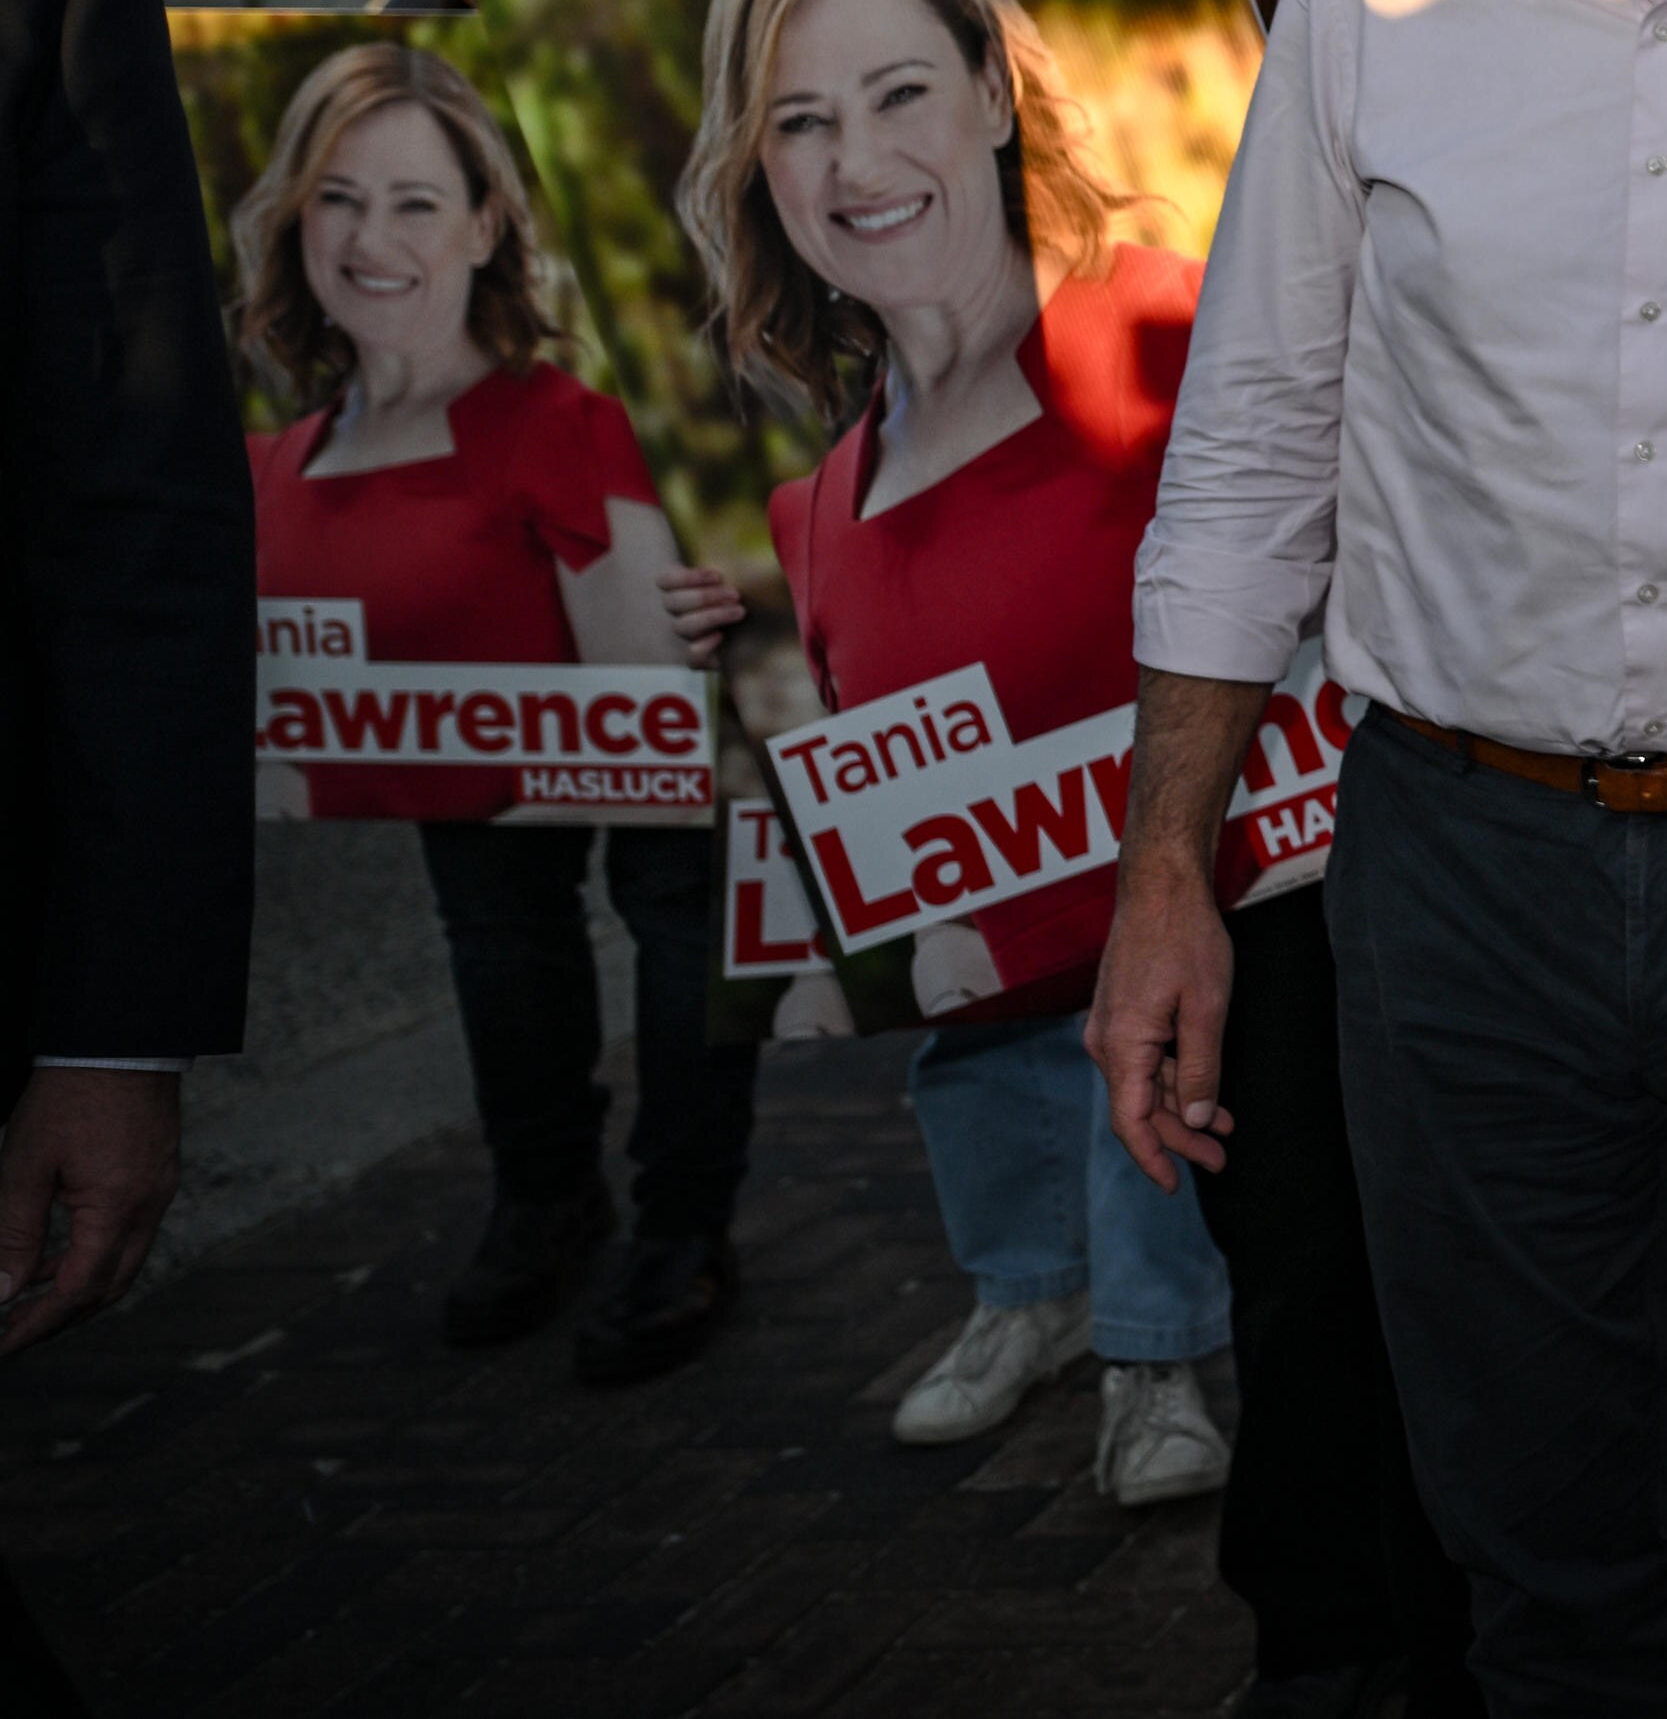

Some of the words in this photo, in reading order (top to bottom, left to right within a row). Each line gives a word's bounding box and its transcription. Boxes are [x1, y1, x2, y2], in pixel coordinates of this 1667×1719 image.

[256, 686, 701, 757] awrence
[780, 696, 992, 804] Tania
[521, 768, 704, 804] HASLUCK
[1256, 797, 1338, 860] HA
